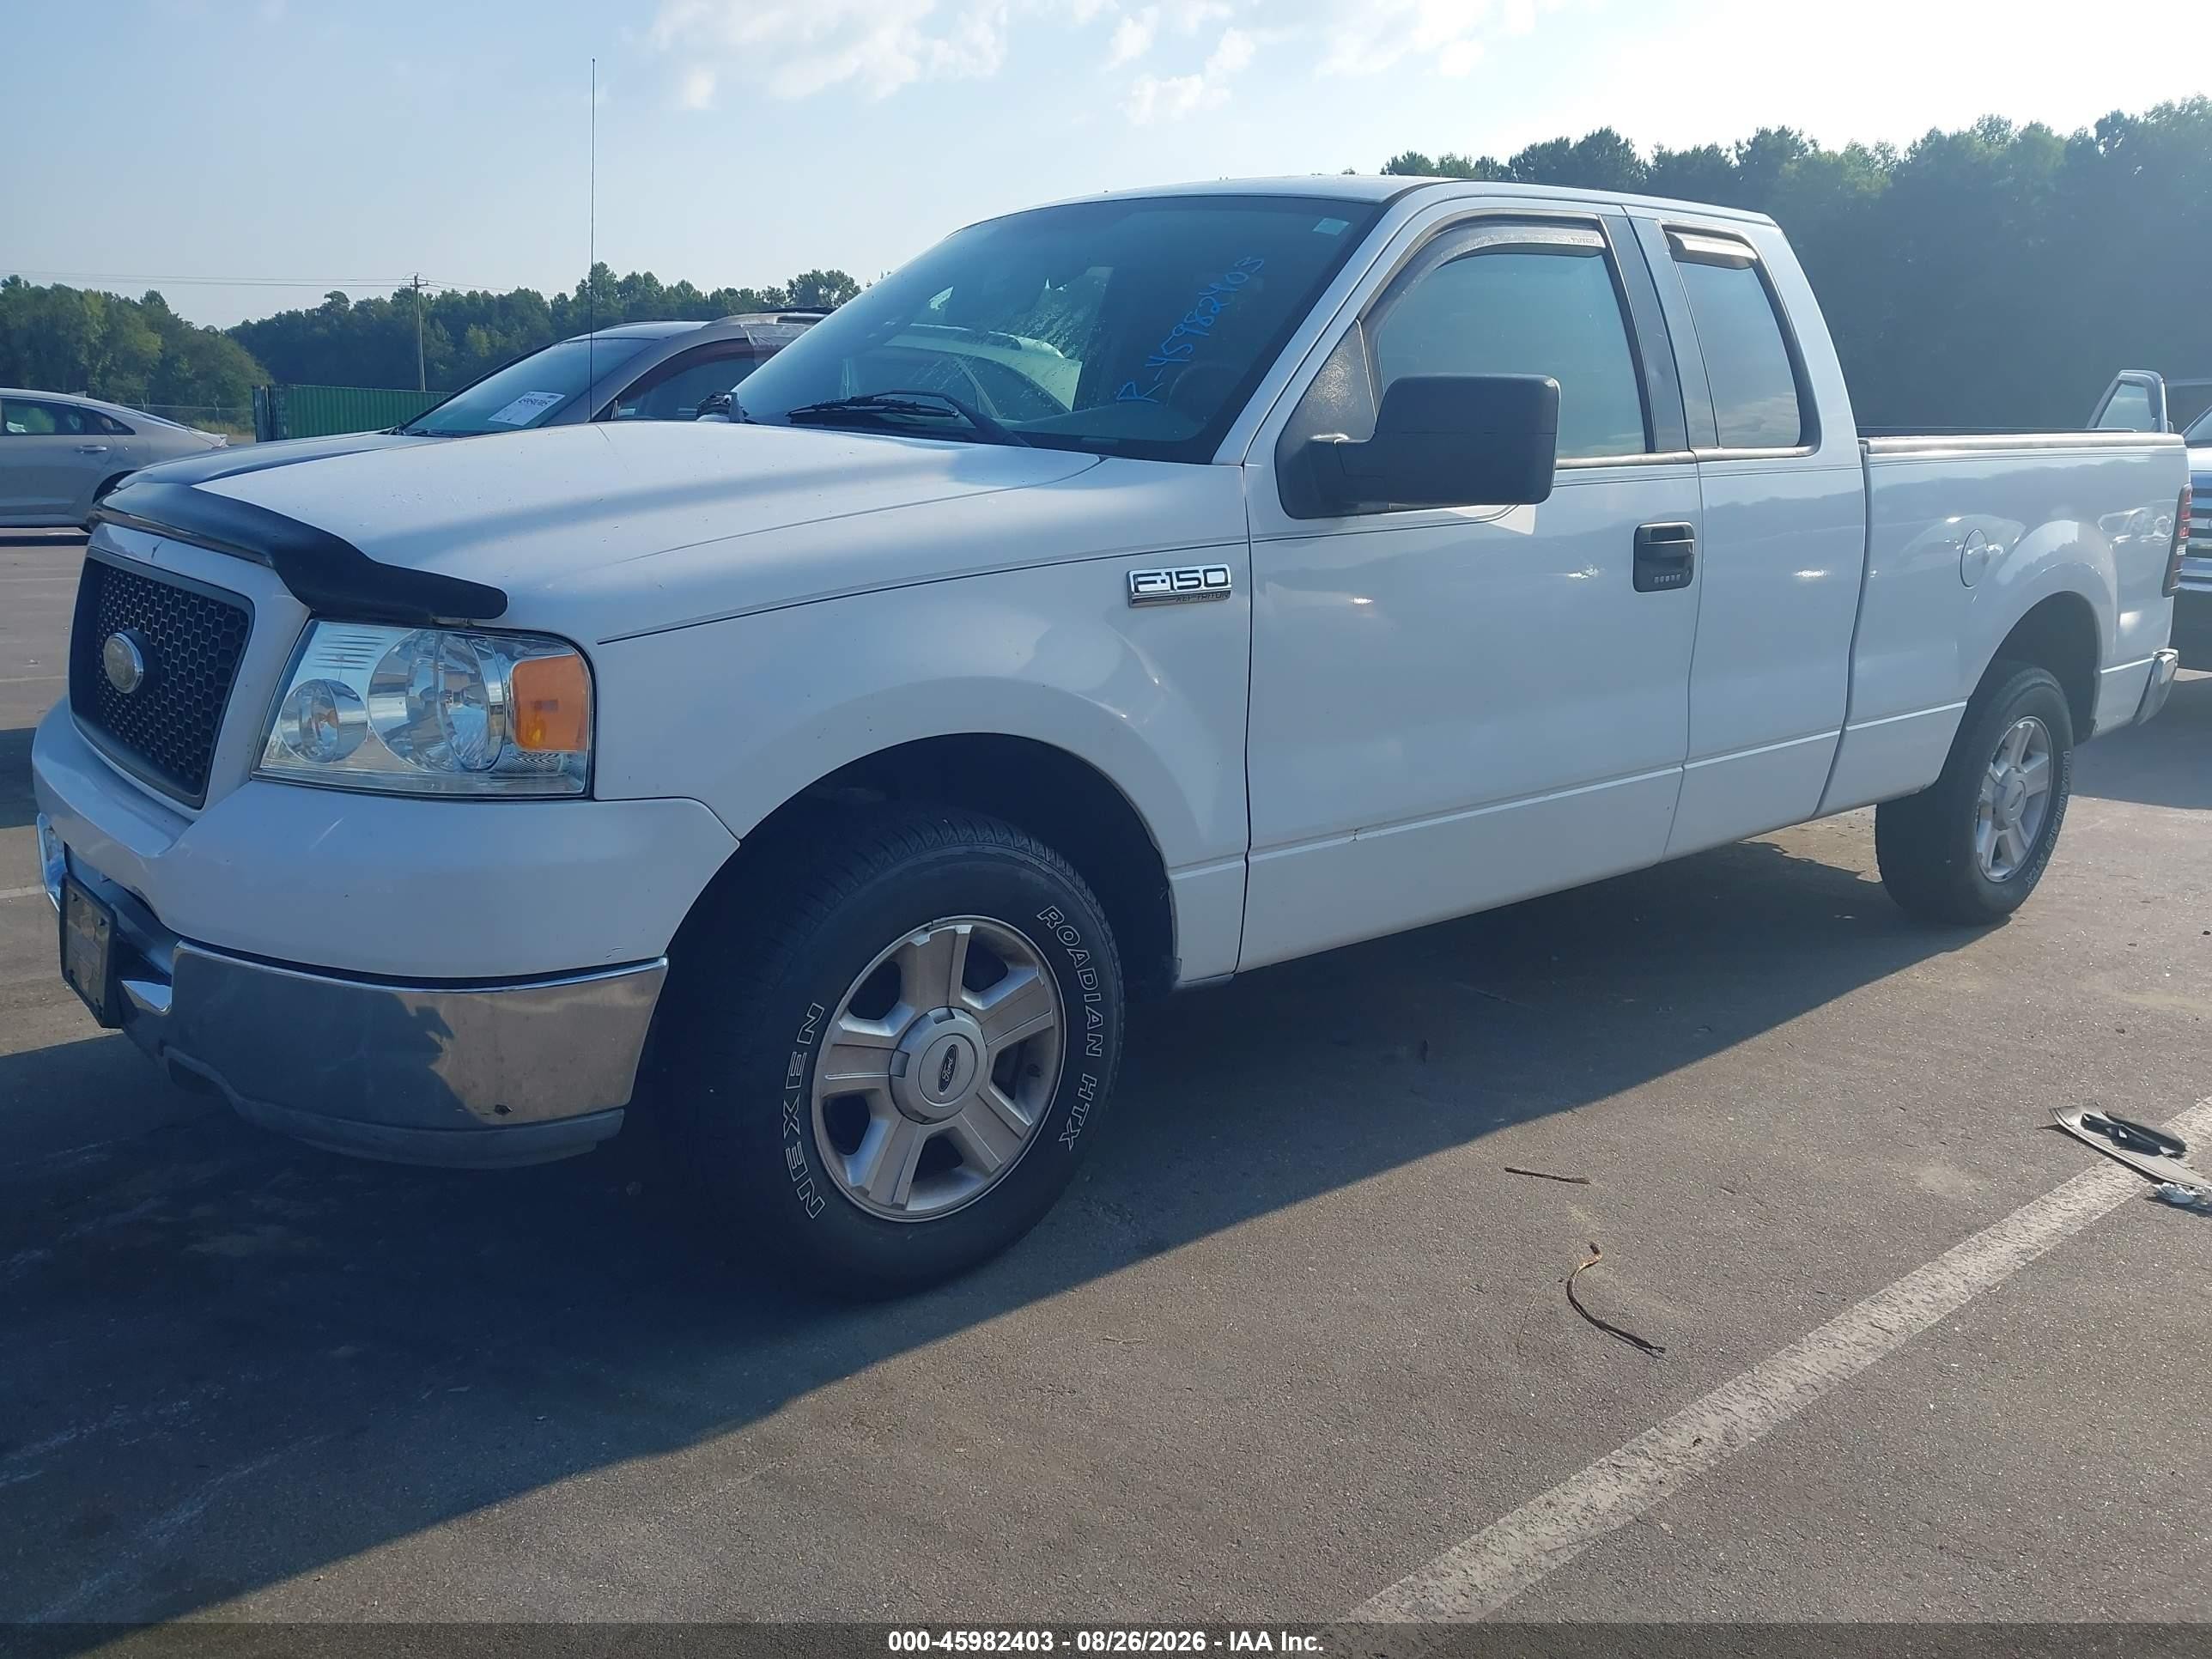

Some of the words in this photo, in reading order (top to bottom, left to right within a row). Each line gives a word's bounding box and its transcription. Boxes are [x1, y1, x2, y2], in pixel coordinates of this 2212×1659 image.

[1133, 567, 1230, 593] F-150
[1036, 905, 1105, 1058] ROADIAN
[782, 1002, 826, 1219] NEXEN
[1058, 1073, 1098, 1152] HTX
